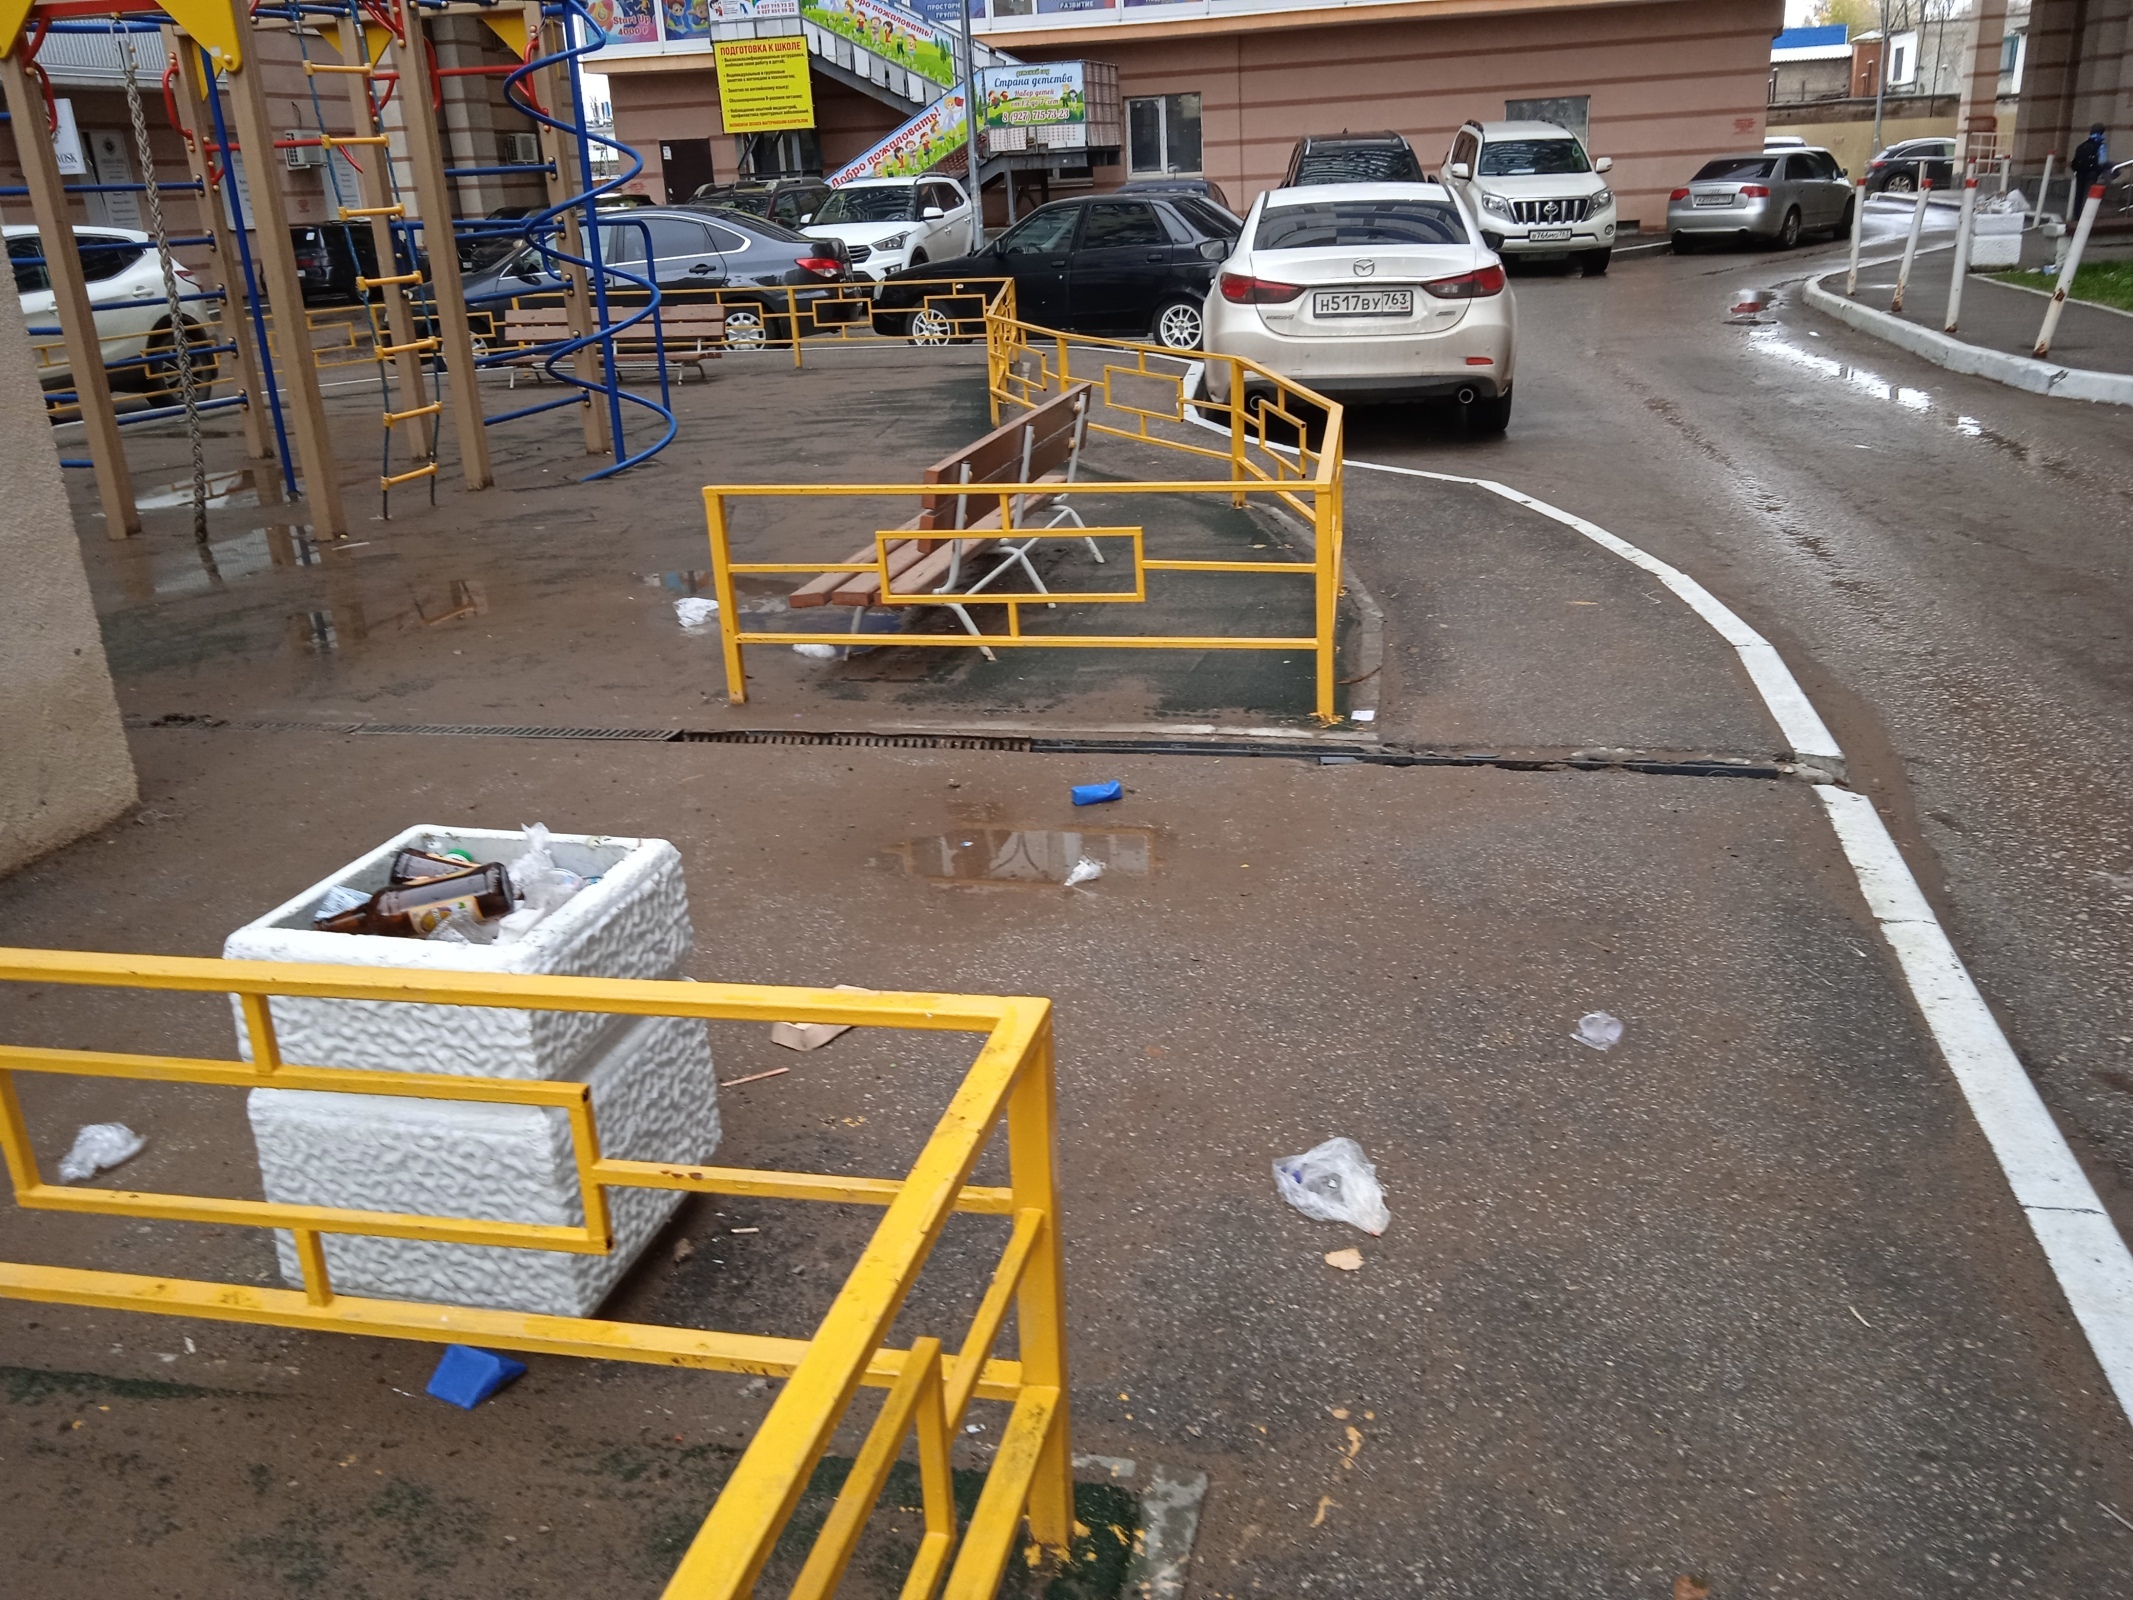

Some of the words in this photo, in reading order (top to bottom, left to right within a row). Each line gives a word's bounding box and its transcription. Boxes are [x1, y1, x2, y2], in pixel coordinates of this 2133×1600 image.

[1059, 0, 1094, 9] РАЗВИТИЕ
[613, 16, 637, 25] Start
[638, 15, 651, 25] Up
[872, 4, 934, 39] пожаловать!
[618, 28, 640, 36] 4000
[720, 44, 767, 56] ПОДГОТОВКА
[768, 43, 774, 52] К
[774, 41, 801, 52] ШКОЛЕ
[994, 77, 1030, 89] Страна
[1031, 73, 1073, 87] детства
[1014, 89, 1033, 98] Набор
[1034, 88, 1055, 97] детей
[1002, 111, 1008, 122] 8
[1010, 110, 1031, 124] (927)
[1031, 108, 1070, 121] 715-73-23
[867, 106, 941, 166] пожаловать!
[1320, 294, 1381, 312] Н517ВУ
[1383, 293, 1407, 306] 763
